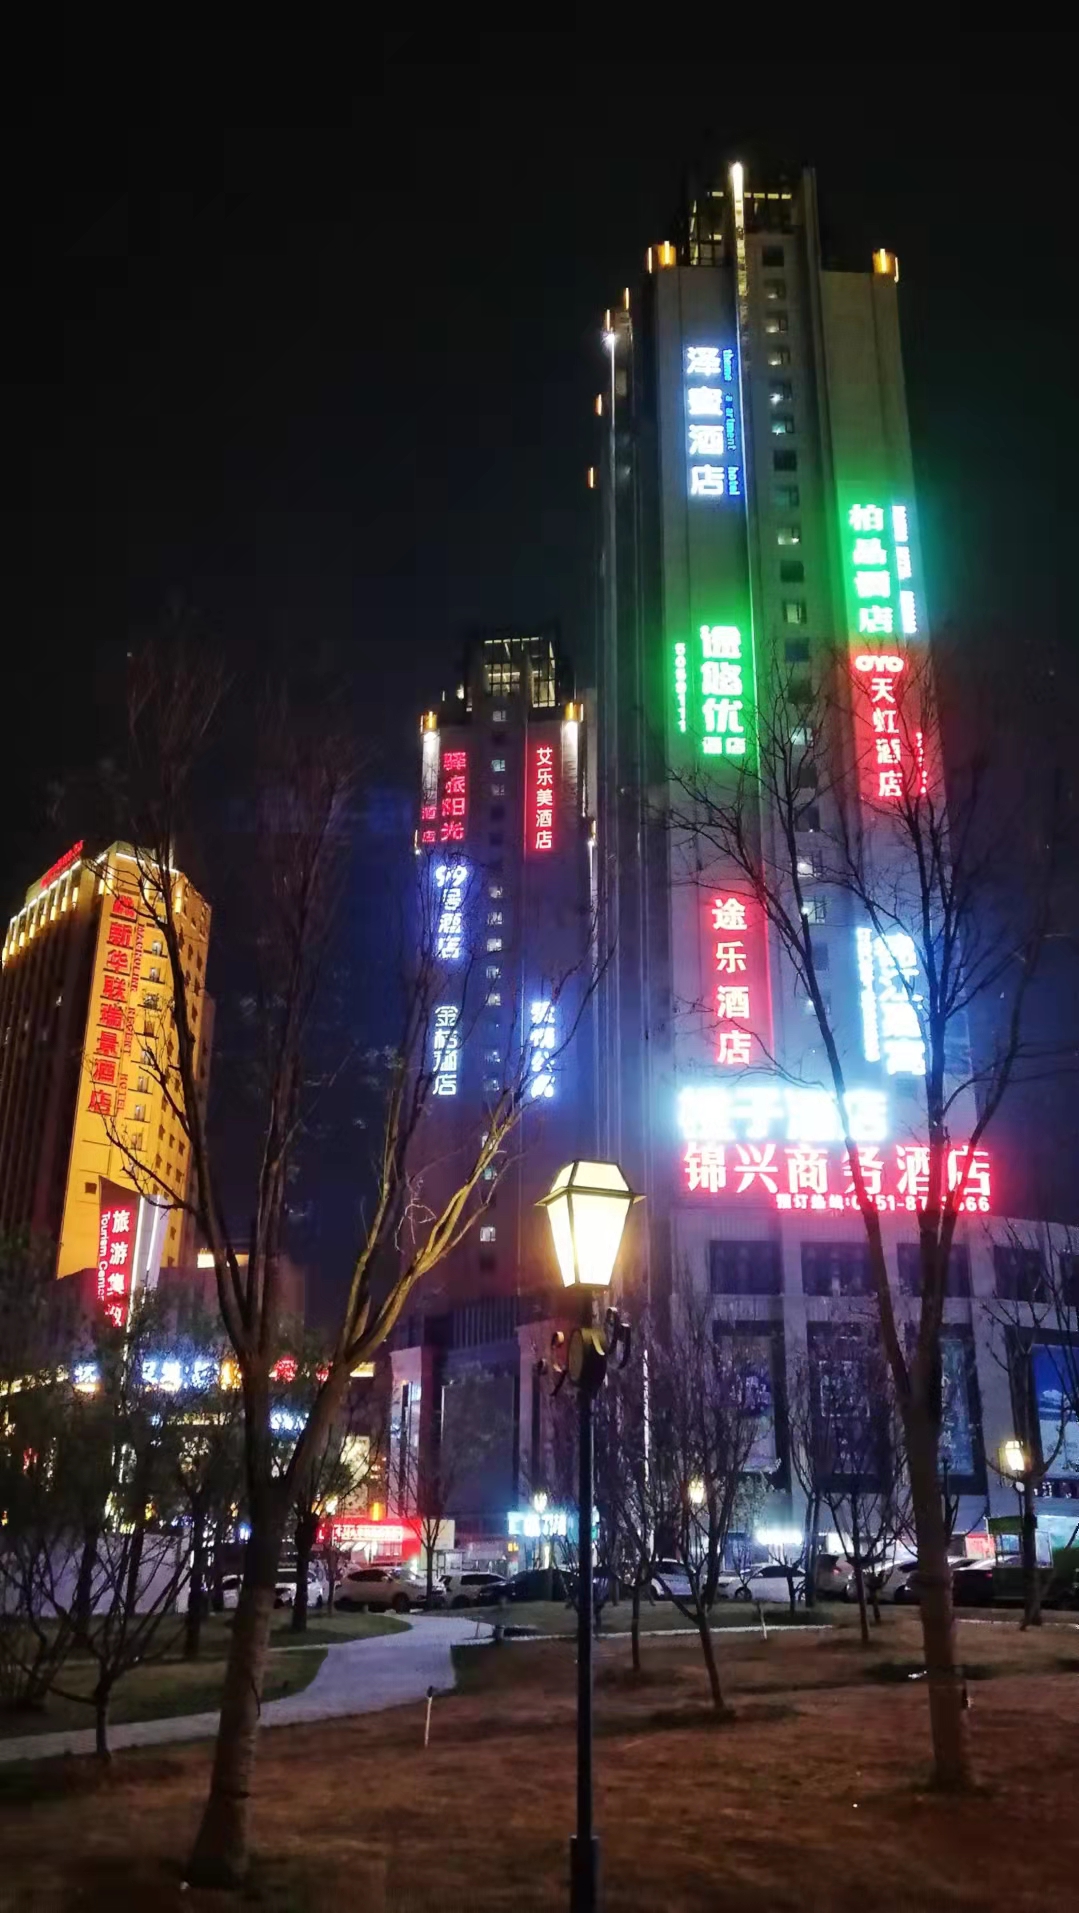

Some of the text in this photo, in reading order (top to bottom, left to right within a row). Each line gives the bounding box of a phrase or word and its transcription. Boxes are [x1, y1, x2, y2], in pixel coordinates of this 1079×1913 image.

[727, 466, 740, 496] hotel
[854, 654, 904, 673] OYO
[535, 746, 554, 850] 艾乐美酒店
[711, 897, 752, 1066] 途乐酒店
[684, 1141, 992, 1195] 锦兴商务酒店
[99, 1211, 111, 1257] Tourism
